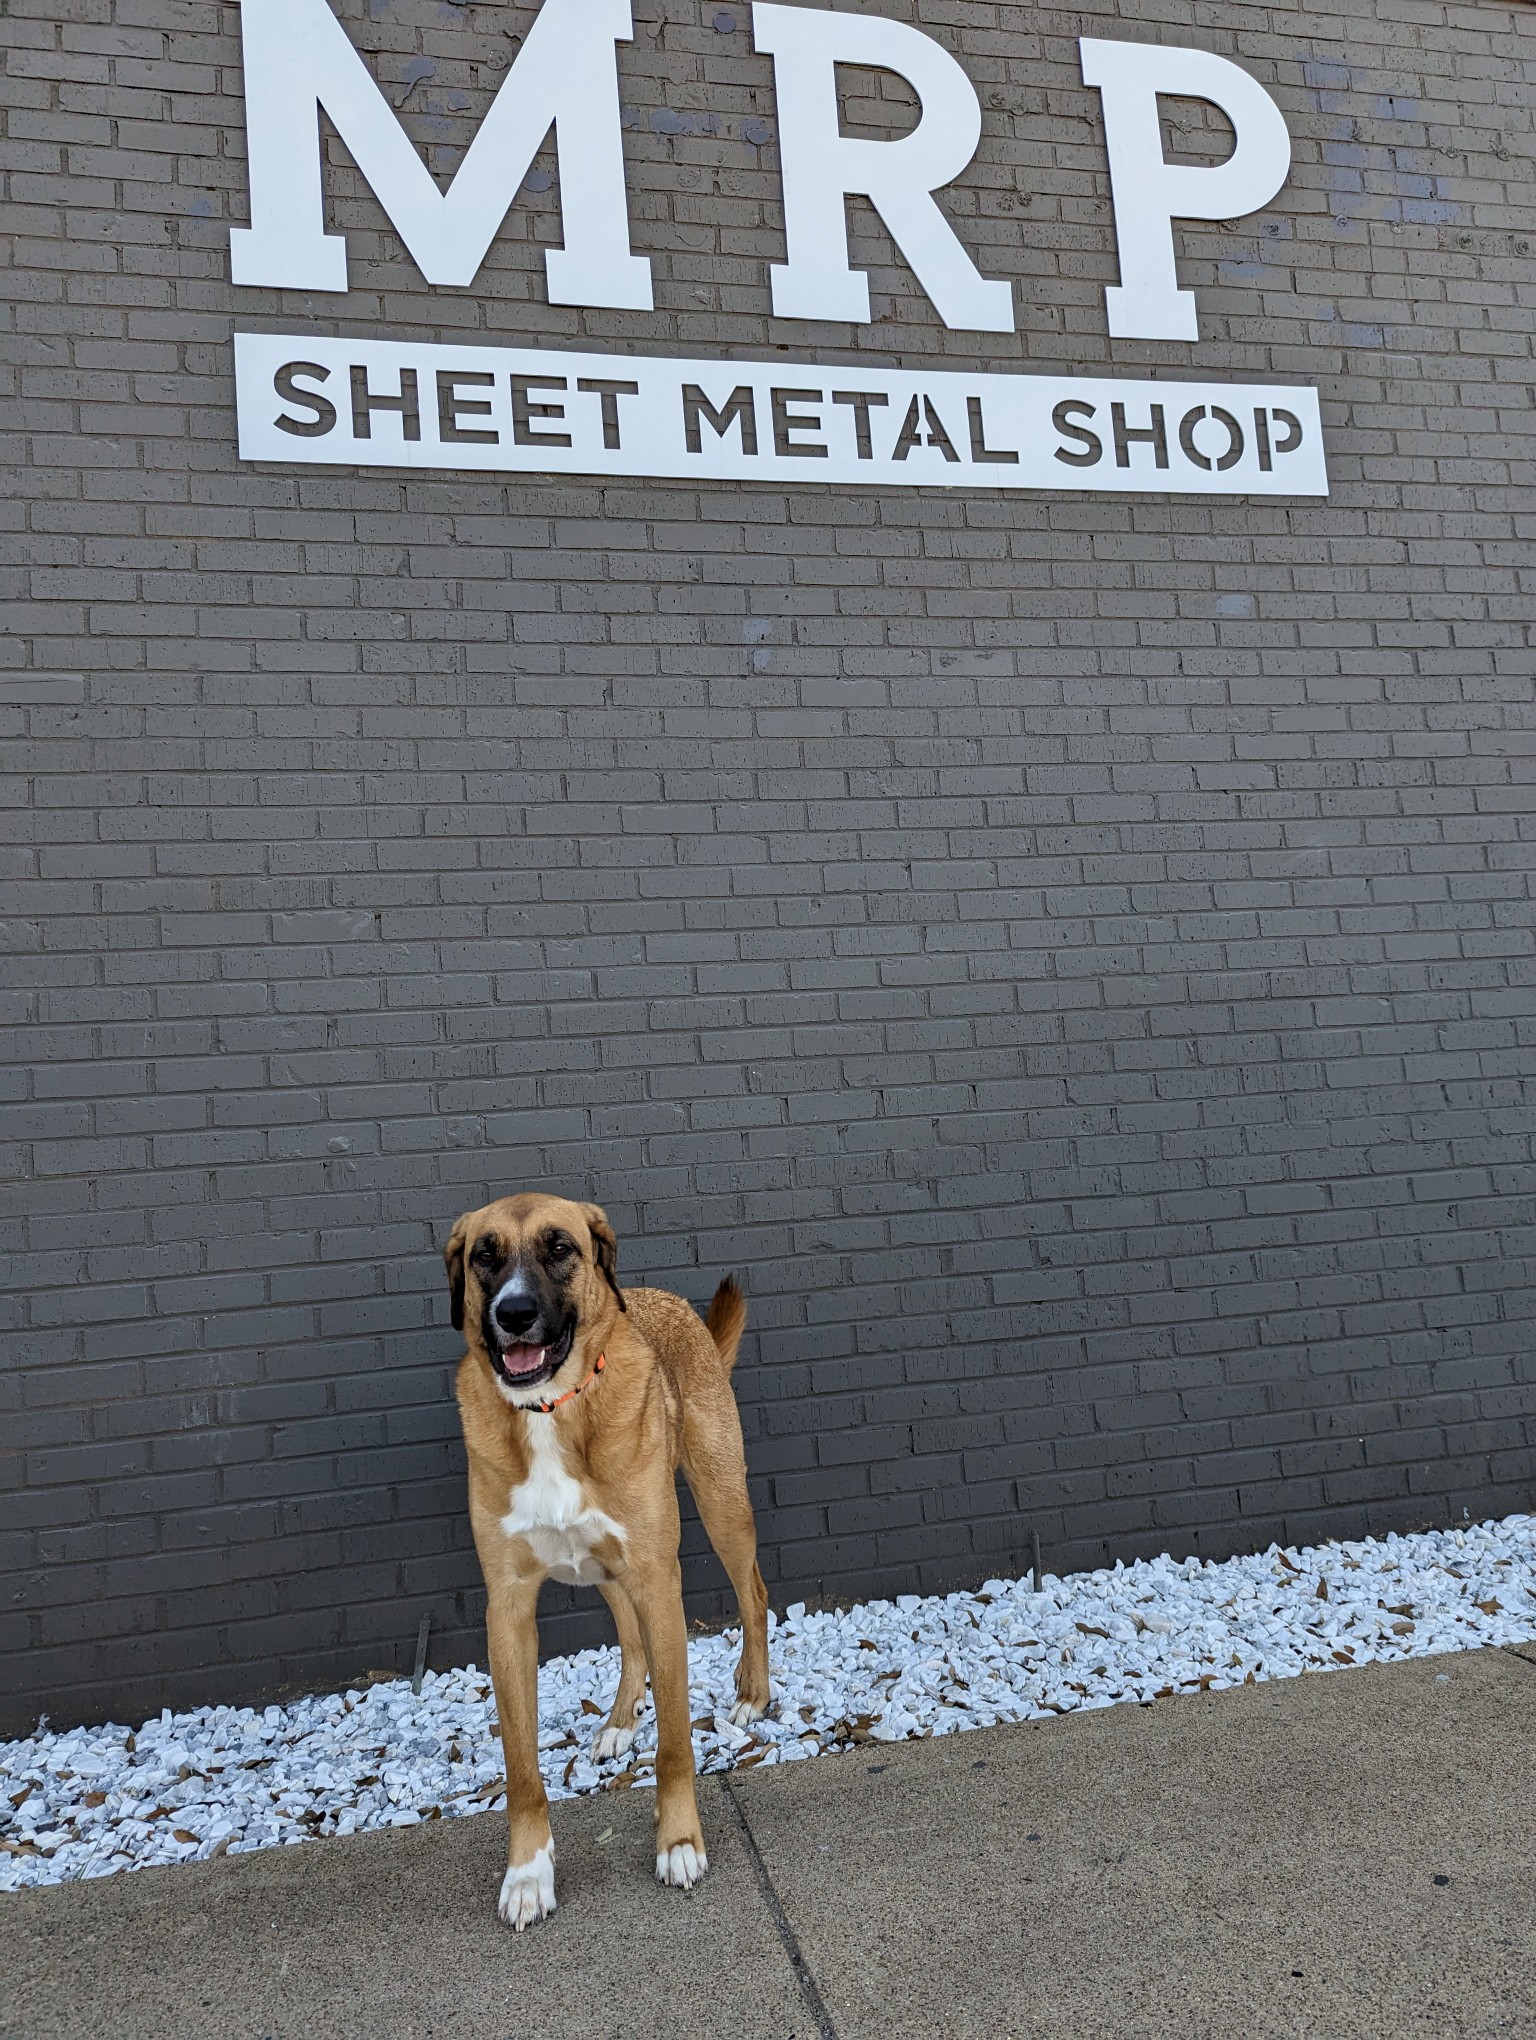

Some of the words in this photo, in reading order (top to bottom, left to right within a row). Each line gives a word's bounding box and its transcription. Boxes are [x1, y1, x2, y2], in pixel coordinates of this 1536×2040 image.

[230, 0, 1291, 342] MRP
[273, 361, 639, 450] SHEET
[682, 384, 1019, 464] METAL
[1051, 399, 1303, 472] SHOP
